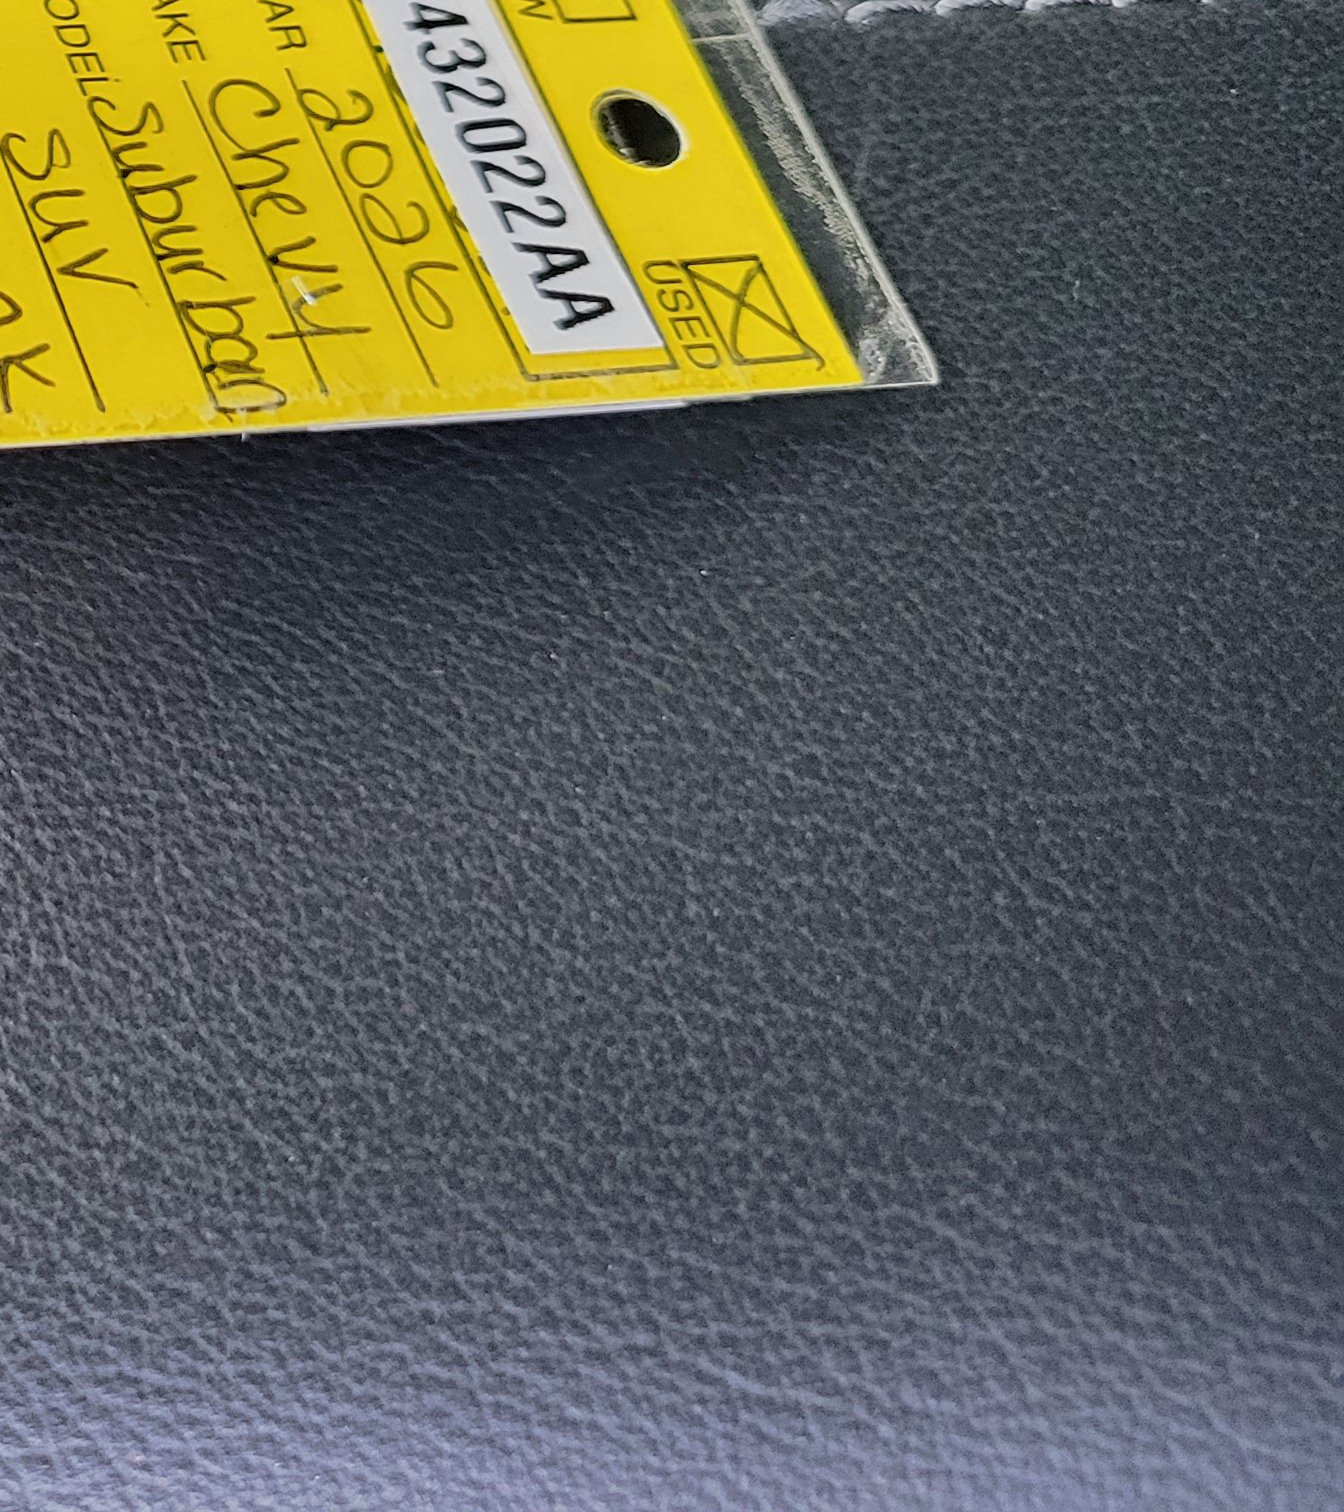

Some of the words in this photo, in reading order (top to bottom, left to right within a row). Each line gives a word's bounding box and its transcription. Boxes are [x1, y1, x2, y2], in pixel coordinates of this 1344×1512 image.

[86, 96, 288, 423] Suburban
[208, 78, 372, 341] Chevy
[297, 88, 459, 330] 2026
[642, 260, 722, 371] USED
